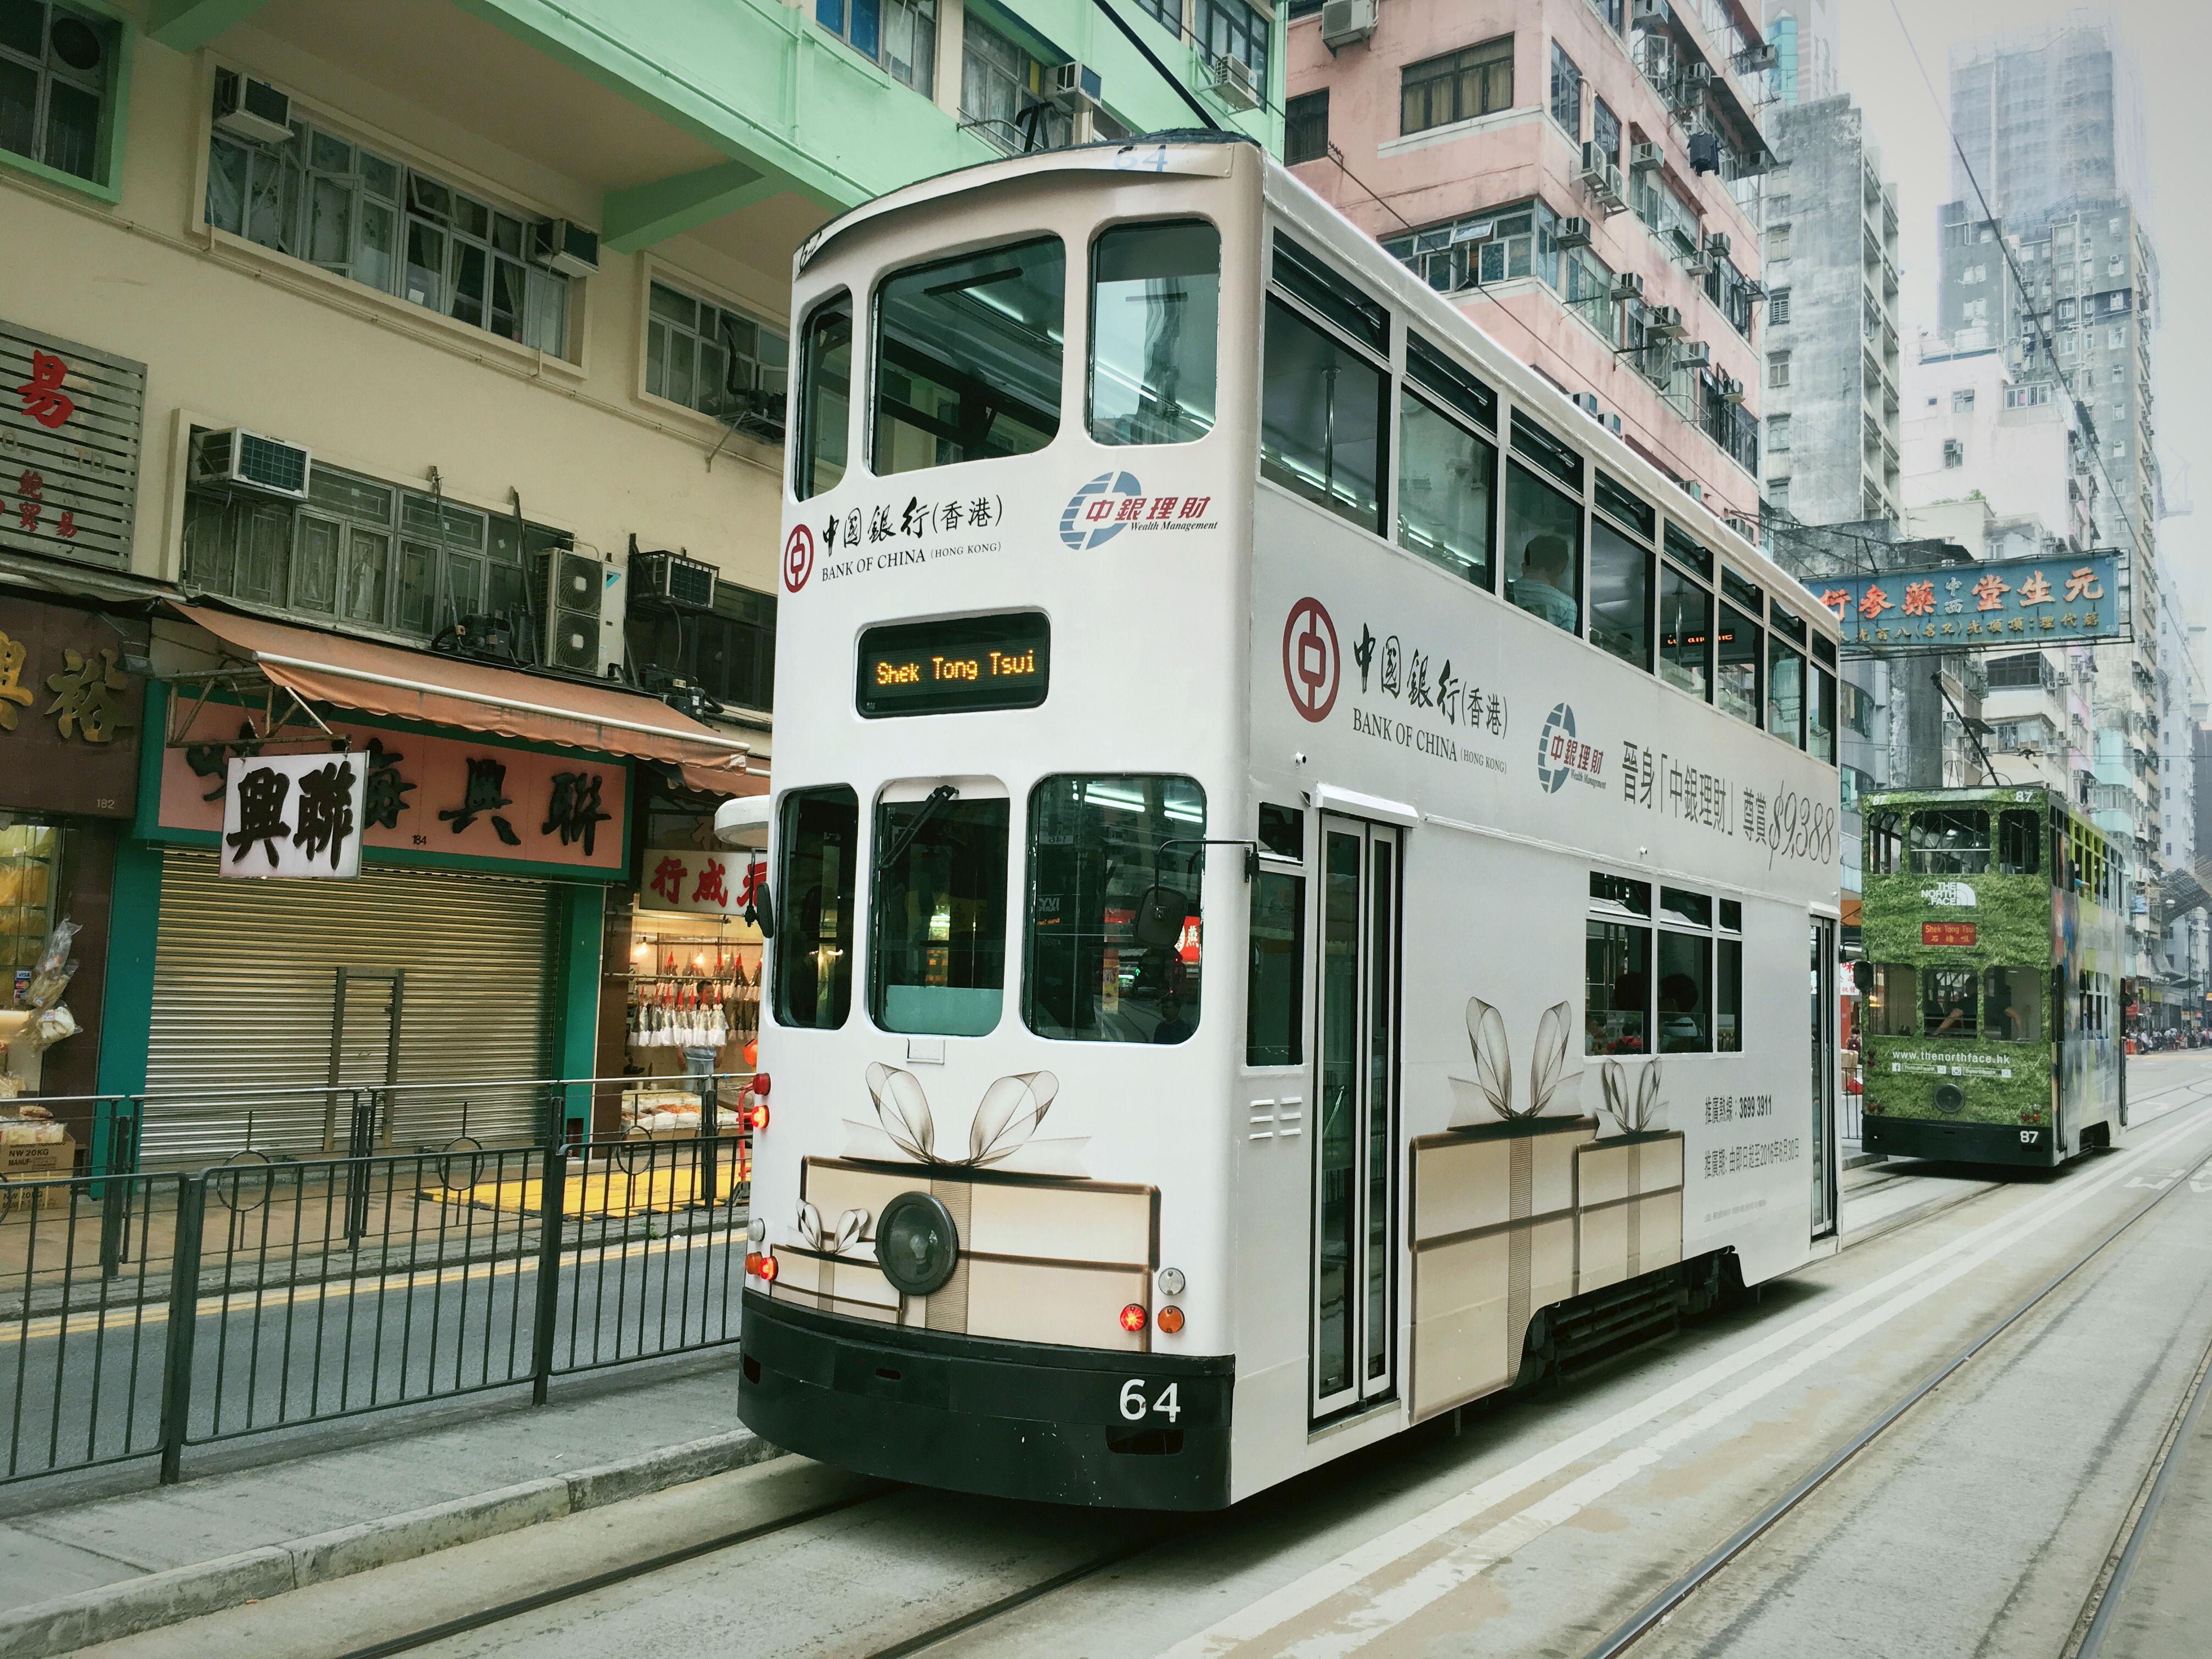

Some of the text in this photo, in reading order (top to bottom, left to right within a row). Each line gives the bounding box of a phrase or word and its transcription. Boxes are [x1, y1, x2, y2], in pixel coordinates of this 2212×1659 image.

[1114, 145, 1168, 172] 64
[17, 349, 75, 428] 易
[1086, 496, 1211, 522] 中銀理財
[823, 494, 1002, 557] 中國銀行(香港)
[1131, 521, 1218, 532] Wealth Management
[822, 541, 1001, 582] BANK OF CHINA (HONG KONG)
[877, 649, 1035, 685] Shek Tong Tsui
[1353, 622, 1507, 740] 中國銀行(香港)
[1353, 708, 1506, 775] BANK OF CHINA (HONG KONG)
[1550, 735, 1604, 775] 中銀理財
[97, 798, 115, 809] 182
[1622, 740, 1733, 836] 晉身「中銀理財」
[1768, 779, 1835, 871] $9,388
[1872, 794, 1888, 806] 87
[2015, 791, 2034, 803] 87
[412, 834, 427, 846] 184
[1921, 889, 1956, 898] NORTH
[1937, 882, 1956, 890] THE
[1925, 924, 1942, 933] Shek
[1944, 925, 1960, 934] Tong
[1893, 1051, 2011, 1064] www.thenorthface.hk
[1739, 1096, 1755, 1119] 3699
[1757, 1094, 1772, 1117] 3911
[2020, 1130, 2039, 1143] 87
[25, 1148, 49, 1156] 20KG
[1119, 1378, 1182, 1423] 64
